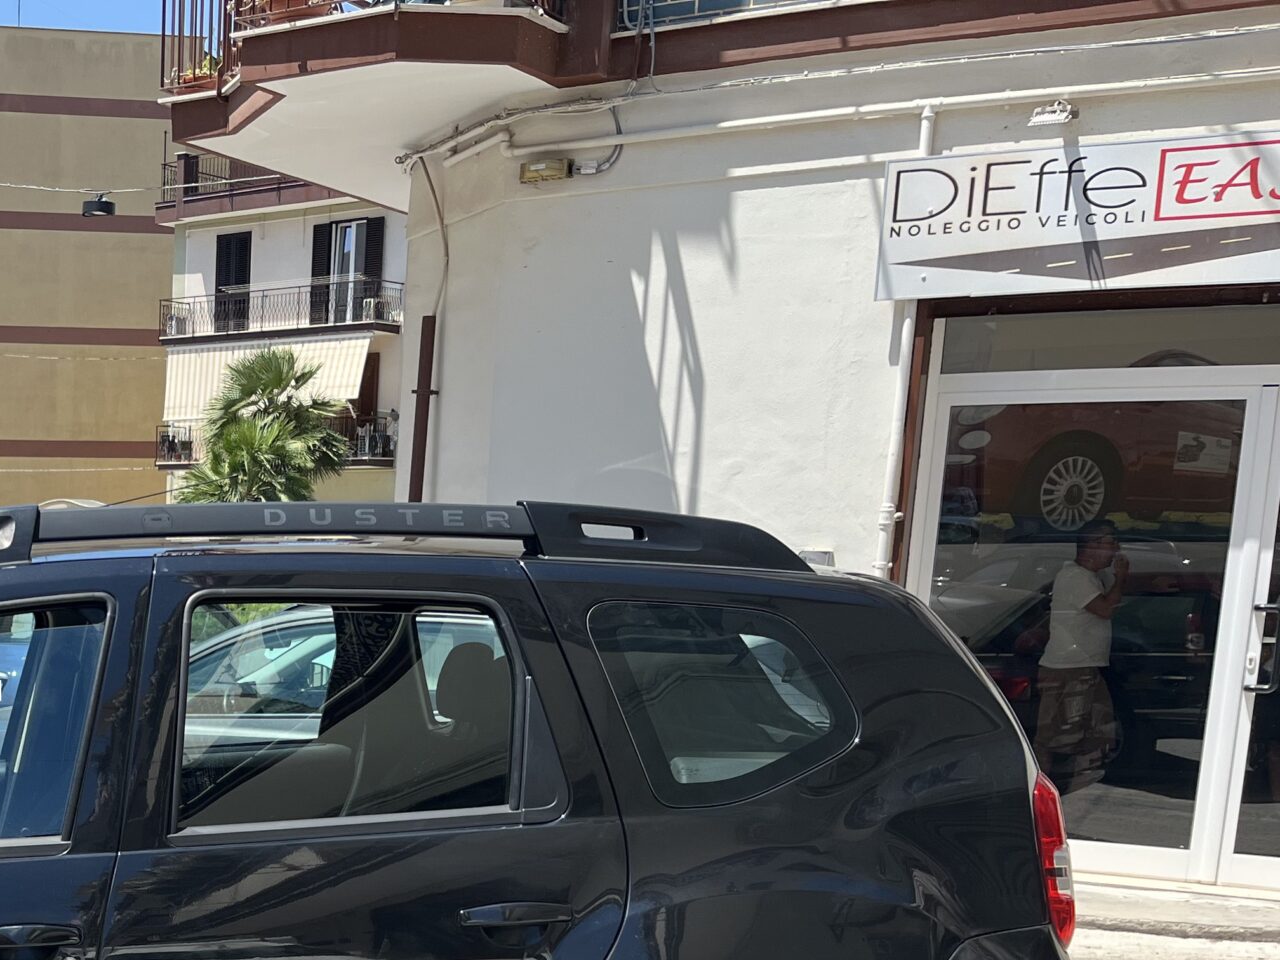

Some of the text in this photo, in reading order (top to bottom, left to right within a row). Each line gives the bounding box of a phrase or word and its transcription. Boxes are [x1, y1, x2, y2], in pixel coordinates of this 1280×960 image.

[892, 156, 1148, 223] DiEffe
[1173, 157, 1280, 204] EA
[890, 210, 1146, 238] NOLEGGIO VEICOLI
[264, 509, 510, 529] DUSTER
